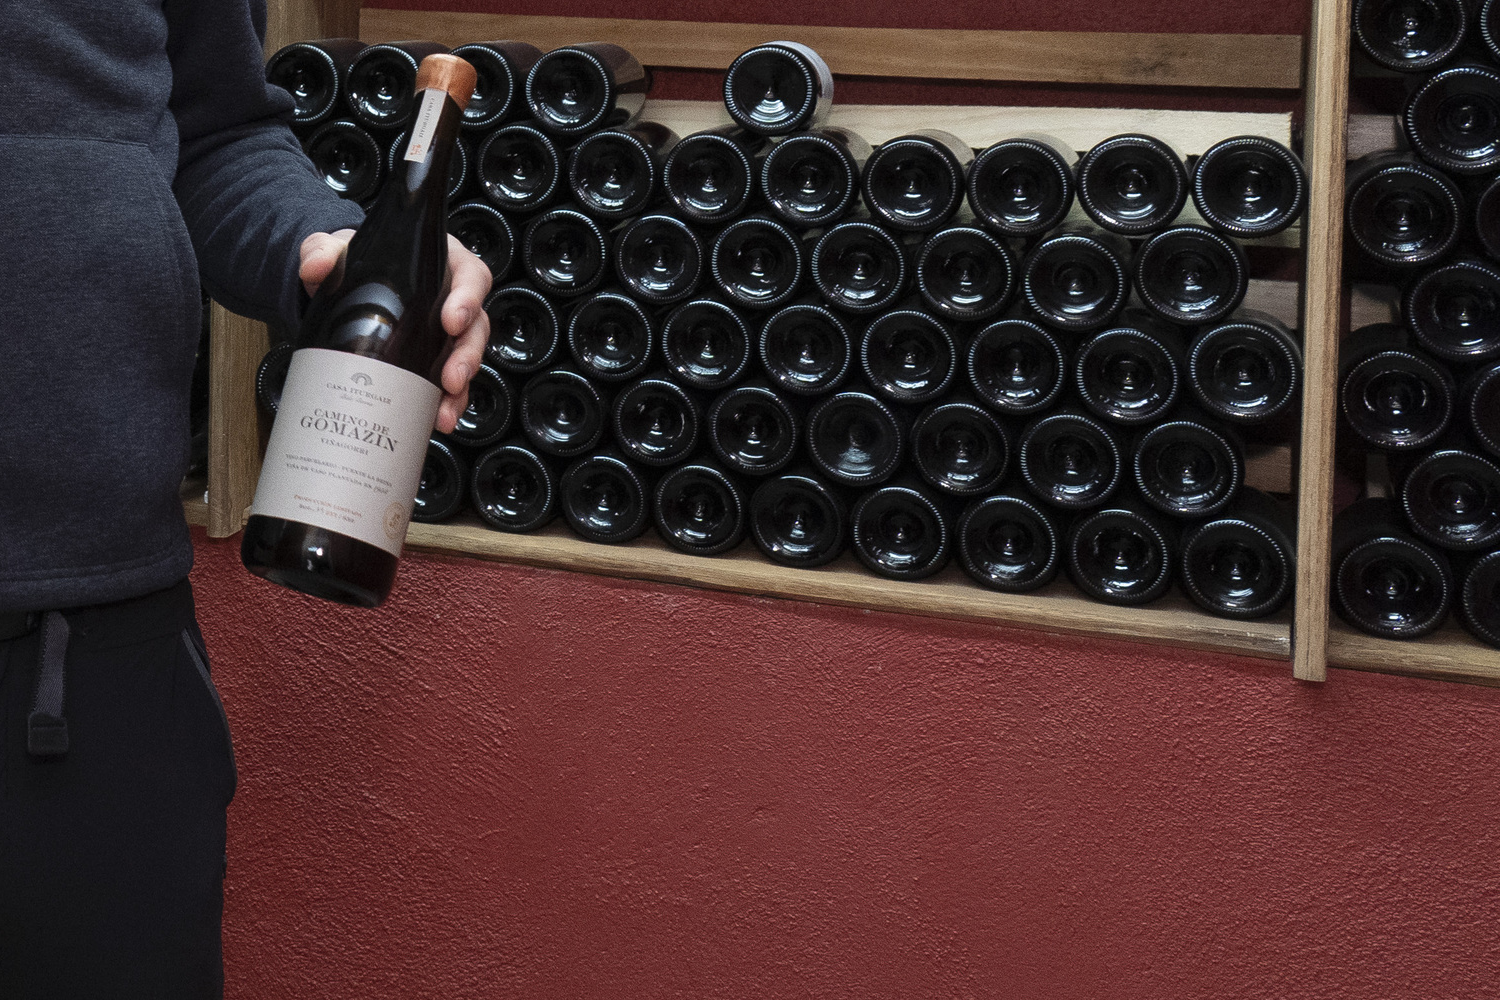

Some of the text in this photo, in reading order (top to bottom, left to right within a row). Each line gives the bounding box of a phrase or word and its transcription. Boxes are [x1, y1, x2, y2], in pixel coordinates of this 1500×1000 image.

[326, 382, 347, 392] CASA
[314, 408, 390, 435] CAMINO DE
[300, 415, 398, 452] GOMAZIN
[320, 437, 369, 456] VIÑAGORRI
